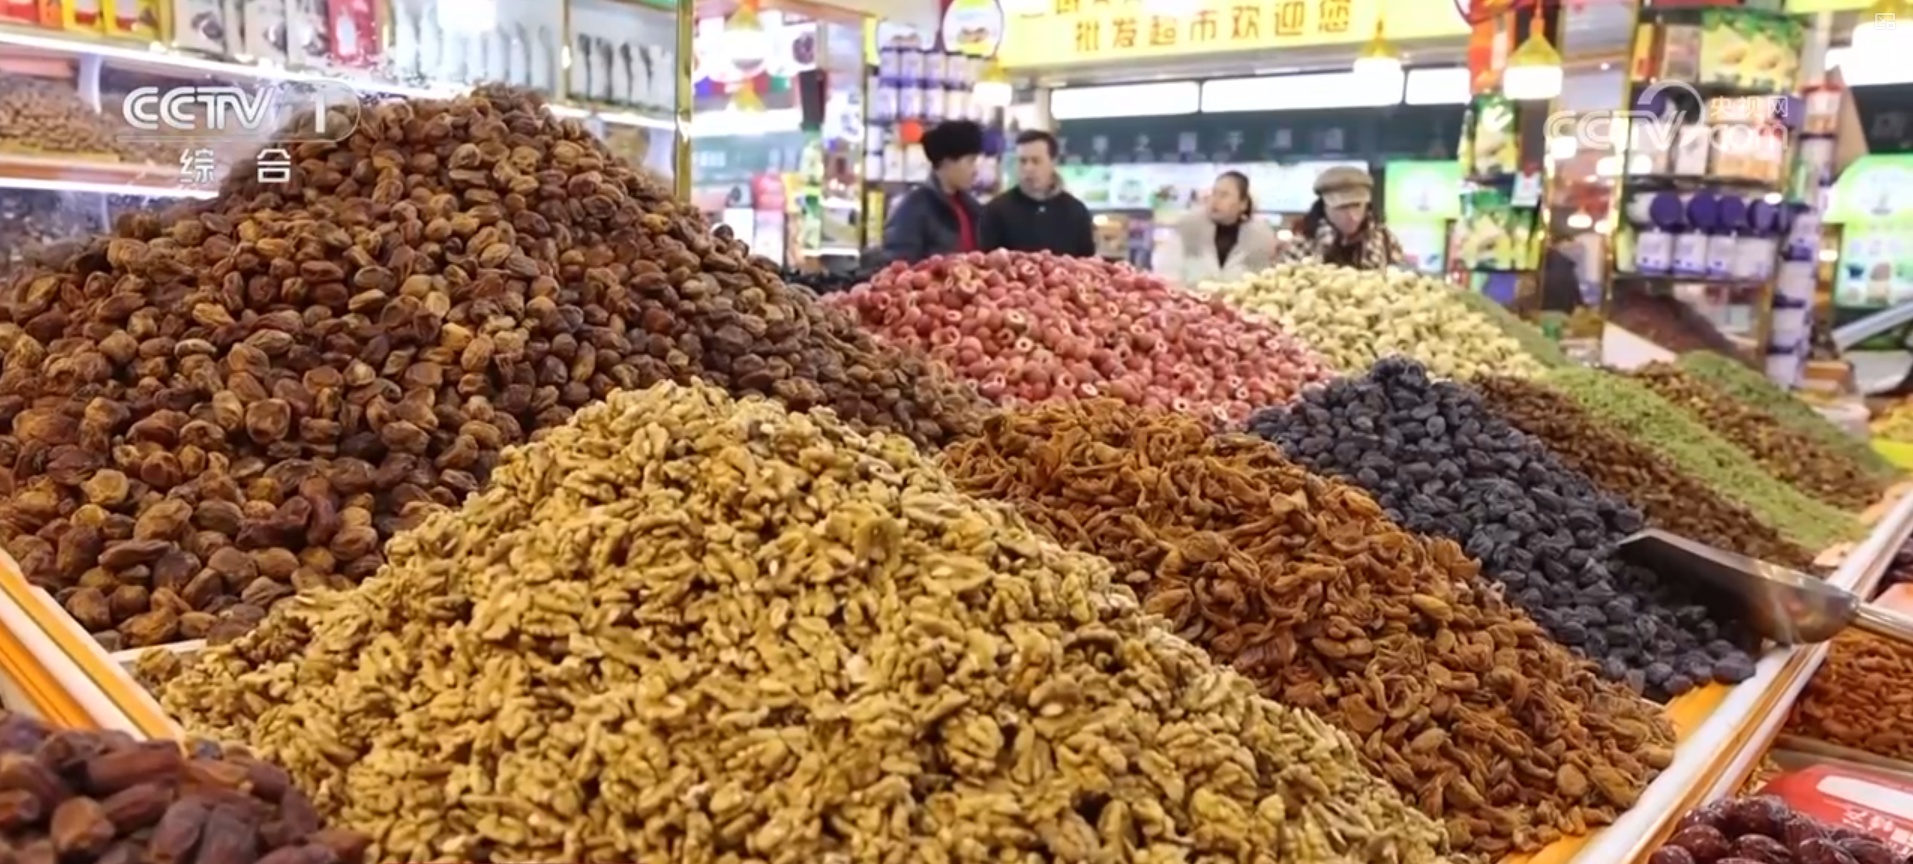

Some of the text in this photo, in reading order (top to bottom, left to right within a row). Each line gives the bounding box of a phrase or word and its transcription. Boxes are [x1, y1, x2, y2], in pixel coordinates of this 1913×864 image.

[1076, 1, 1350, 51] 批发超市欢迎您
